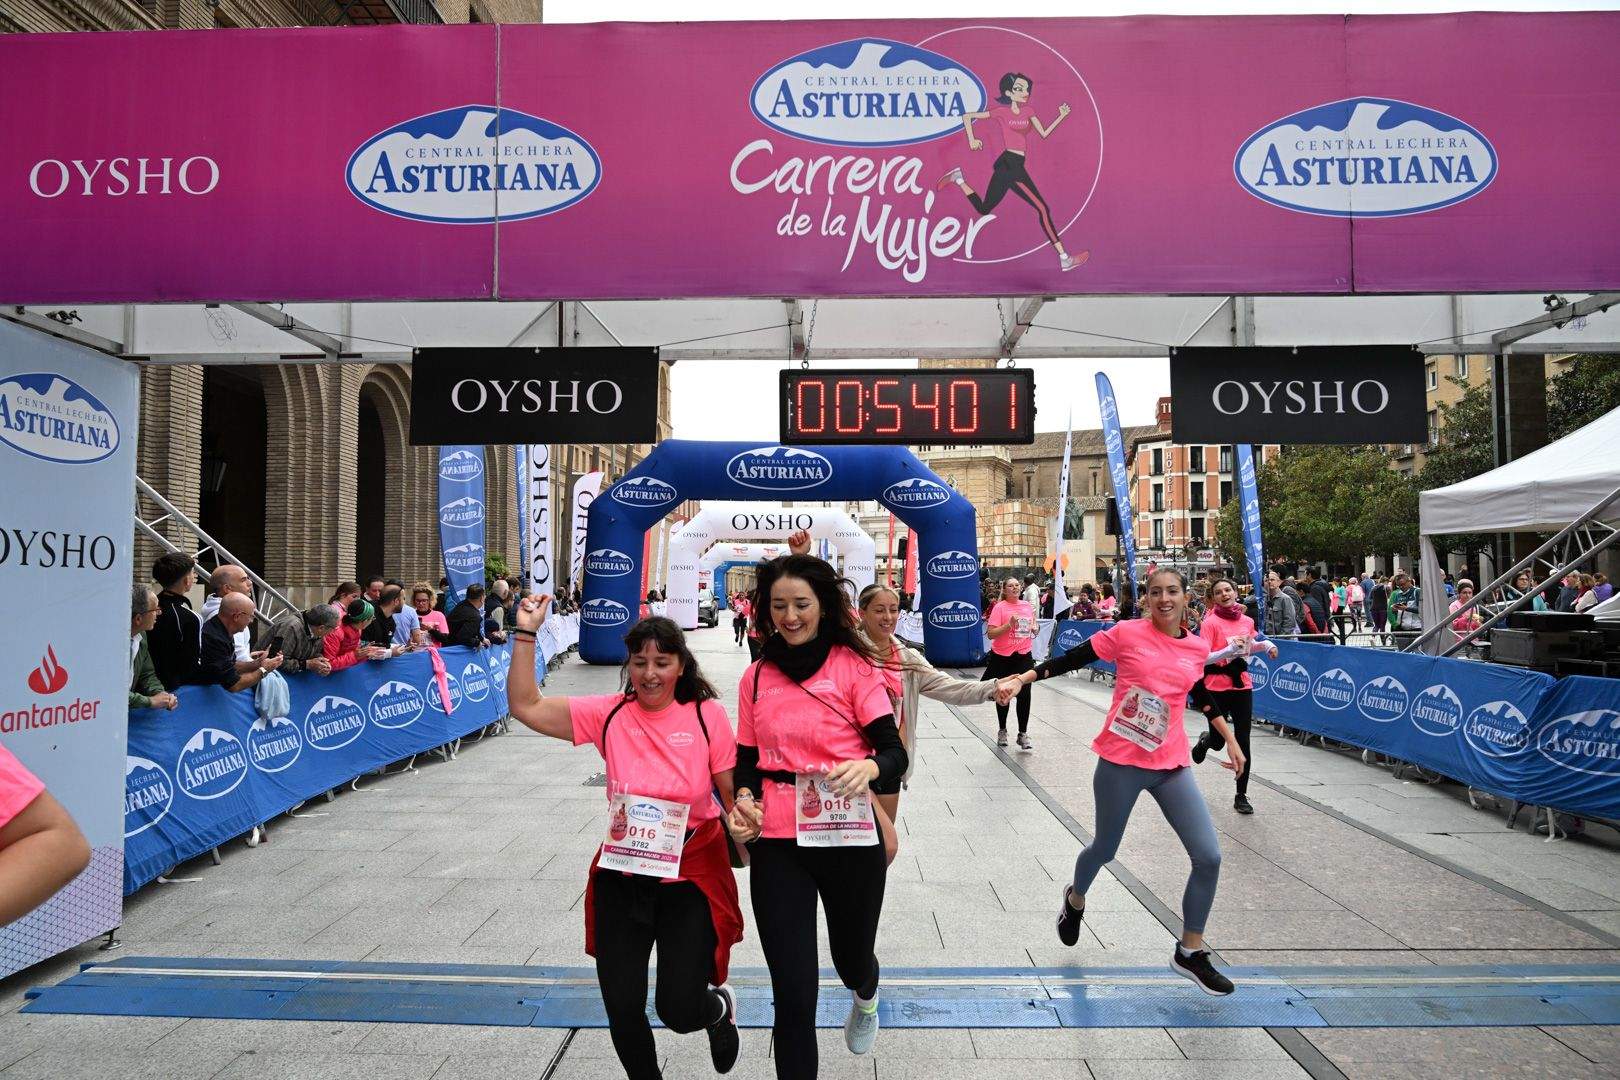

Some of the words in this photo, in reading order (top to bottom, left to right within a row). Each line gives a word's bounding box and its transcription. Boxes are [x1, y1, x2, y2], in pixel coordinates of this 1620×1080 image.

[805, 75, 878, 86] CENTRAL
[886, 75, 961, 86] LECHERA
[768, 79, 967, 118] ASTURIANA
[405, 146, 483, 159] CENTRAL
[491, 144, 575, 157] LECHERA
[1295, 139, 1376, 151] CENTRAL
[1385, 137, 1469, 149] LECHERA
[365, 150, 581, 194] ASTURIANA
[730, 138, 923, 195] Carrera
[1255, 142, 1478, 186] ASTURIANA
[29, 156, 220, 198] OYSHO
[776, 197, 812, 236] de
[821, 197, 847, 236] la
[841, 189, 997, 283] Mujer
[451, 378, 623, 414] OYSHO
[1212, 379, 1389, 415] OYSHO
[17, 395, 62, 414] CENTRAL
[66, 408, 108, 425] LECHERA
[735, 459, 824, 480] ASTURIANA
[615, 487, 672, 501] ASTURIANA
[889, 489, 946, 502] ASTURIANA
[533, 444, 550, 585] OYSHO
[732, 513, 813, 531] OYSHO
[587, 558, 630, 571] ASTURIANA
[930, 561, 976, 573] ASTURIANA
[583, 607, 626, 620] ASTURIANA
[932, 612, 978, 623] ASTURIANA
[464, 679, 488, 695] ASTURIANA
[1272, 673, 1307, 693] ASTURIANA
[1314, 681, 1351, 702] ASTURIANA
[374, 698, 422, 722] ASTURIANA
[1360, 690, 1403, 713] ASTURIANA
[0, 697, 100, 733] antander
[1138, 711, 1155, 725] 016
[310, 714, 363, 742] ASTURIANA
[252, 734, 300, 762] ASTURIANA
[1545, 728, 1620, 760] ASTURI
[184, 752, 246, 791] ASTURIANA
[824, 799, 851, 811] 016
[829, 813, 847, 821] 9780
[629, 825, 656, 840] 016
[804, 834, 831, 842] OYSHO
[610, 847, 630, 855] CARRERA
[631, 840, 650, 849] 9782
[606, 857, 629, 866] OYSHO
